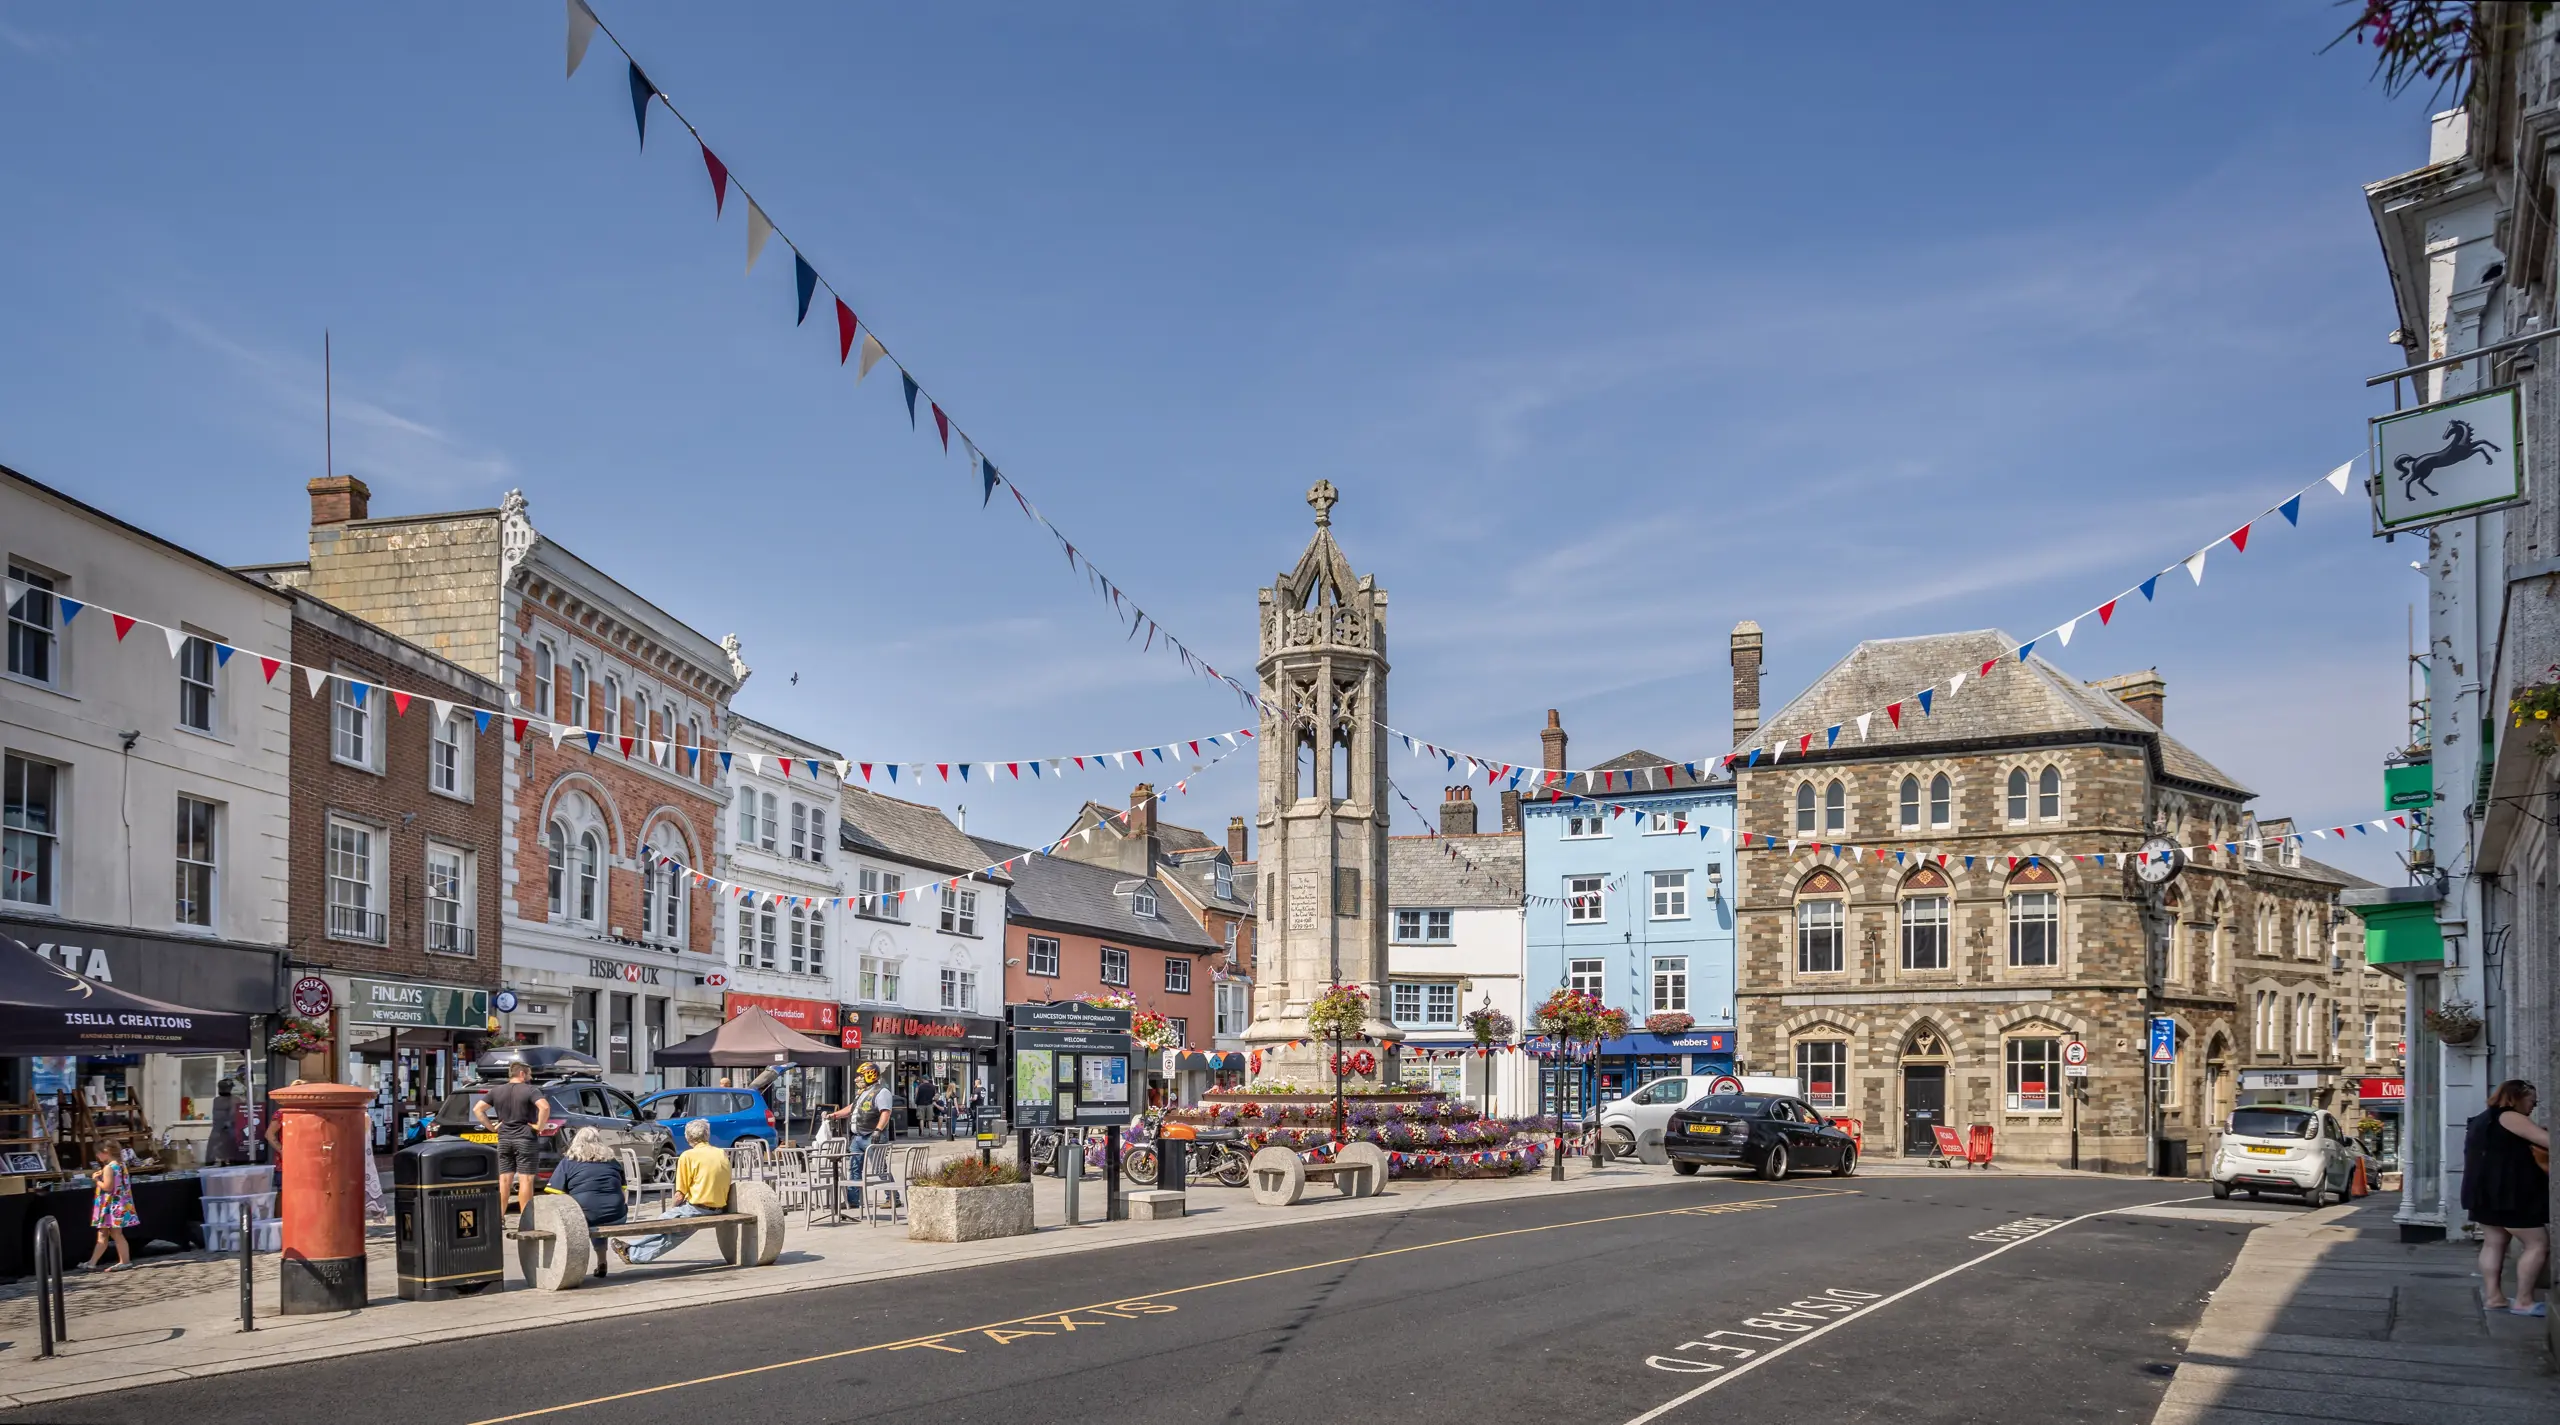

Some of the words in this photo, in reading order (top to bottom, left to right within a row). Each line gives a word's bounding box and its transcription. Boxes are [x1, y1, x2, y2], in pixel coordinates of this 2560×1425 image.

[2393, 793, 2428, 802] Specsavers
[589, 958, 624, 980] HSBC
[641, 967, 660, 985] UK
[298, 980, 324, 991] COSTA
[371, 985, 423, 1003] FINLAYS
[297, 1000, 327, 1014] COFFEE
[372, 1010, 422, 1021] NEWSAGENTS
[774, 1008, 805, 1019] Foundation
[1033, 1012, 1067, 1020] LAUNCESTON
[65, 1012, 115, 1026] ISELLA
[119, 1014, 192, 1029] CREATIONS
[873, 1017, 901, 1034] HBH
[1671, 1039, 1709, 1047] webbers
[1940, 1131, 1954, 1140] ROAD
[1942, 1144, 1962, 1152] CLOSED
[888, 1301, 1179, 1354] TAXIS
[1644, 1287, 1883, 1374] DISABLED
